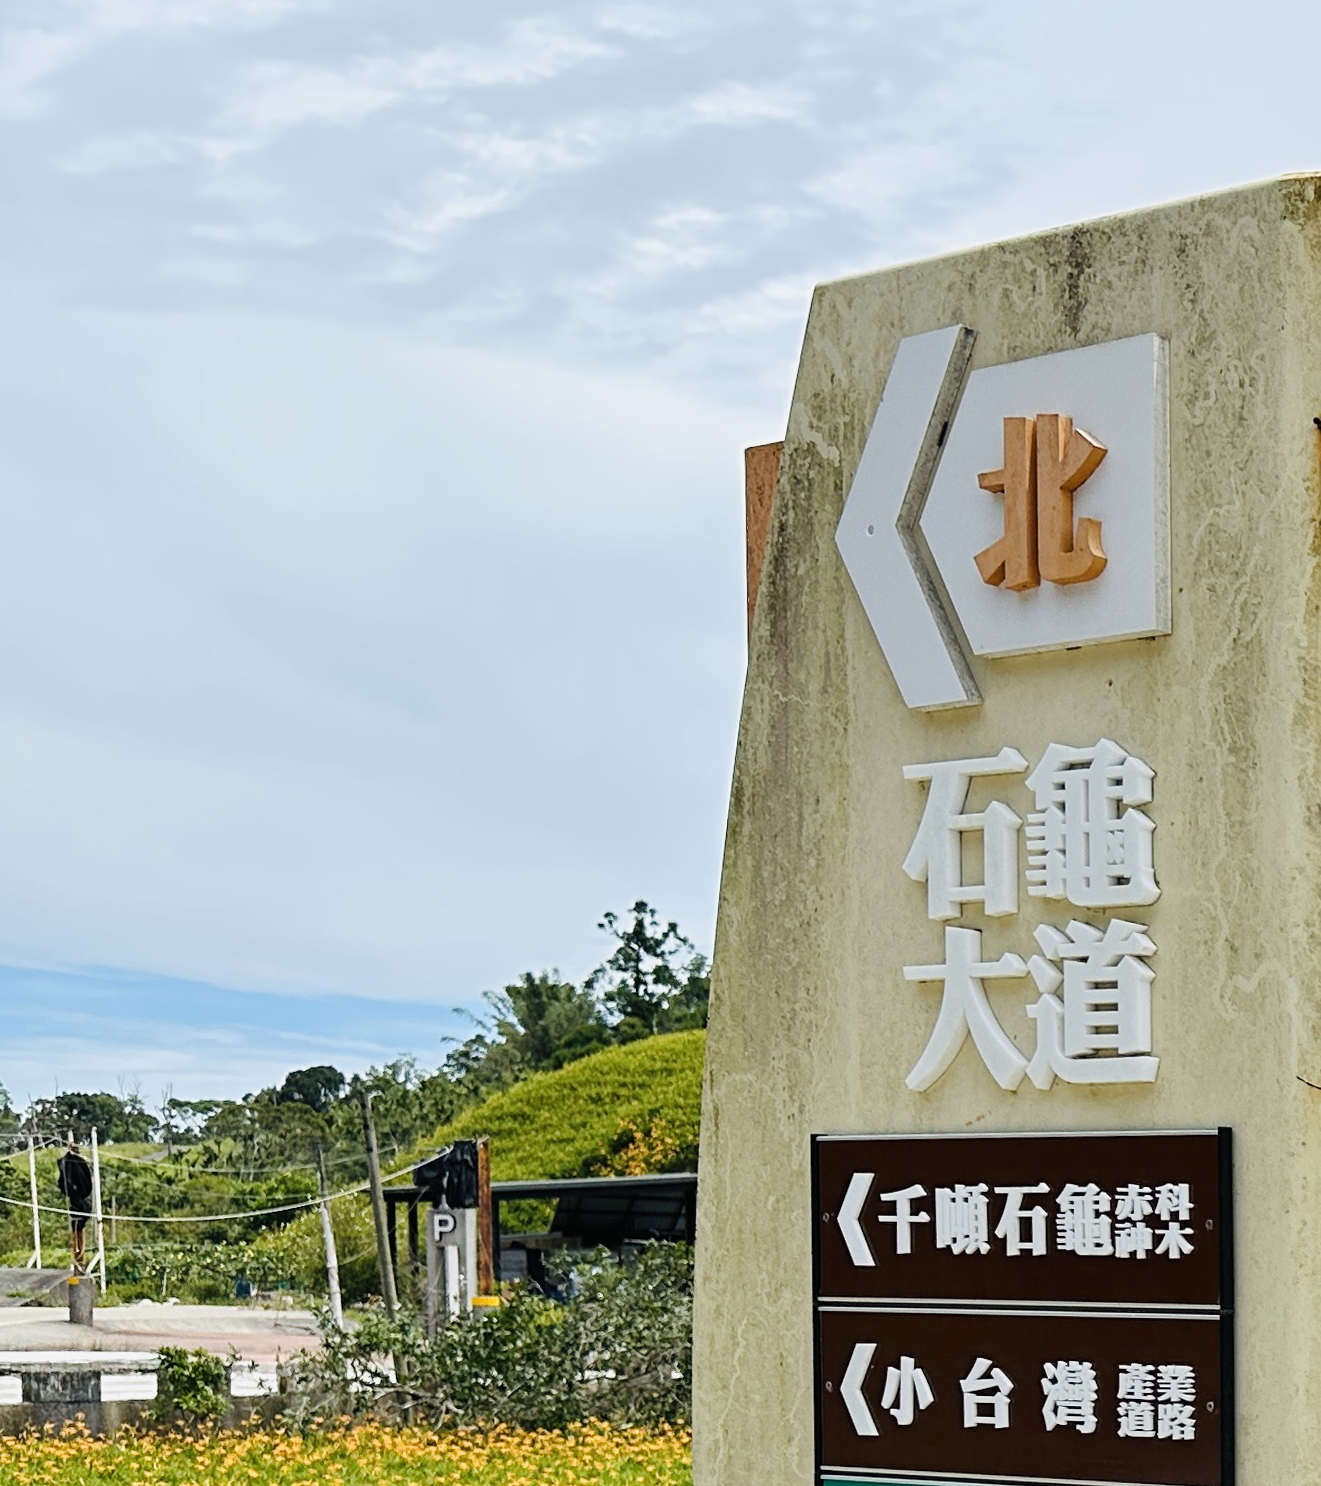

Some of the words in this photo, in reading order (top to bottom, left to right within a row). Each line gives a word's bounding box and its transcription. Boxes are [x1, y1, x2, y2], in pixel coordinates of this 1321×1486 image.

[974, 413, 1108, 594] 北
[900, 735, 1161, 921] 石龜
[899, 918, 1160, 1091] 大道
[433, 1213, 456, 1241] P
[877, 1182, 1114, 1257] 千噸石龜
[1114, 1183, 1195, 1221] 赤科
[1114, 1221, 1195, 1260] 神木
[881, 1356, 1098, 1434] 小台灣
[1116, 1362, 1196, 1402] 產業
[1116, 1401, 1196, 1440] 道路
